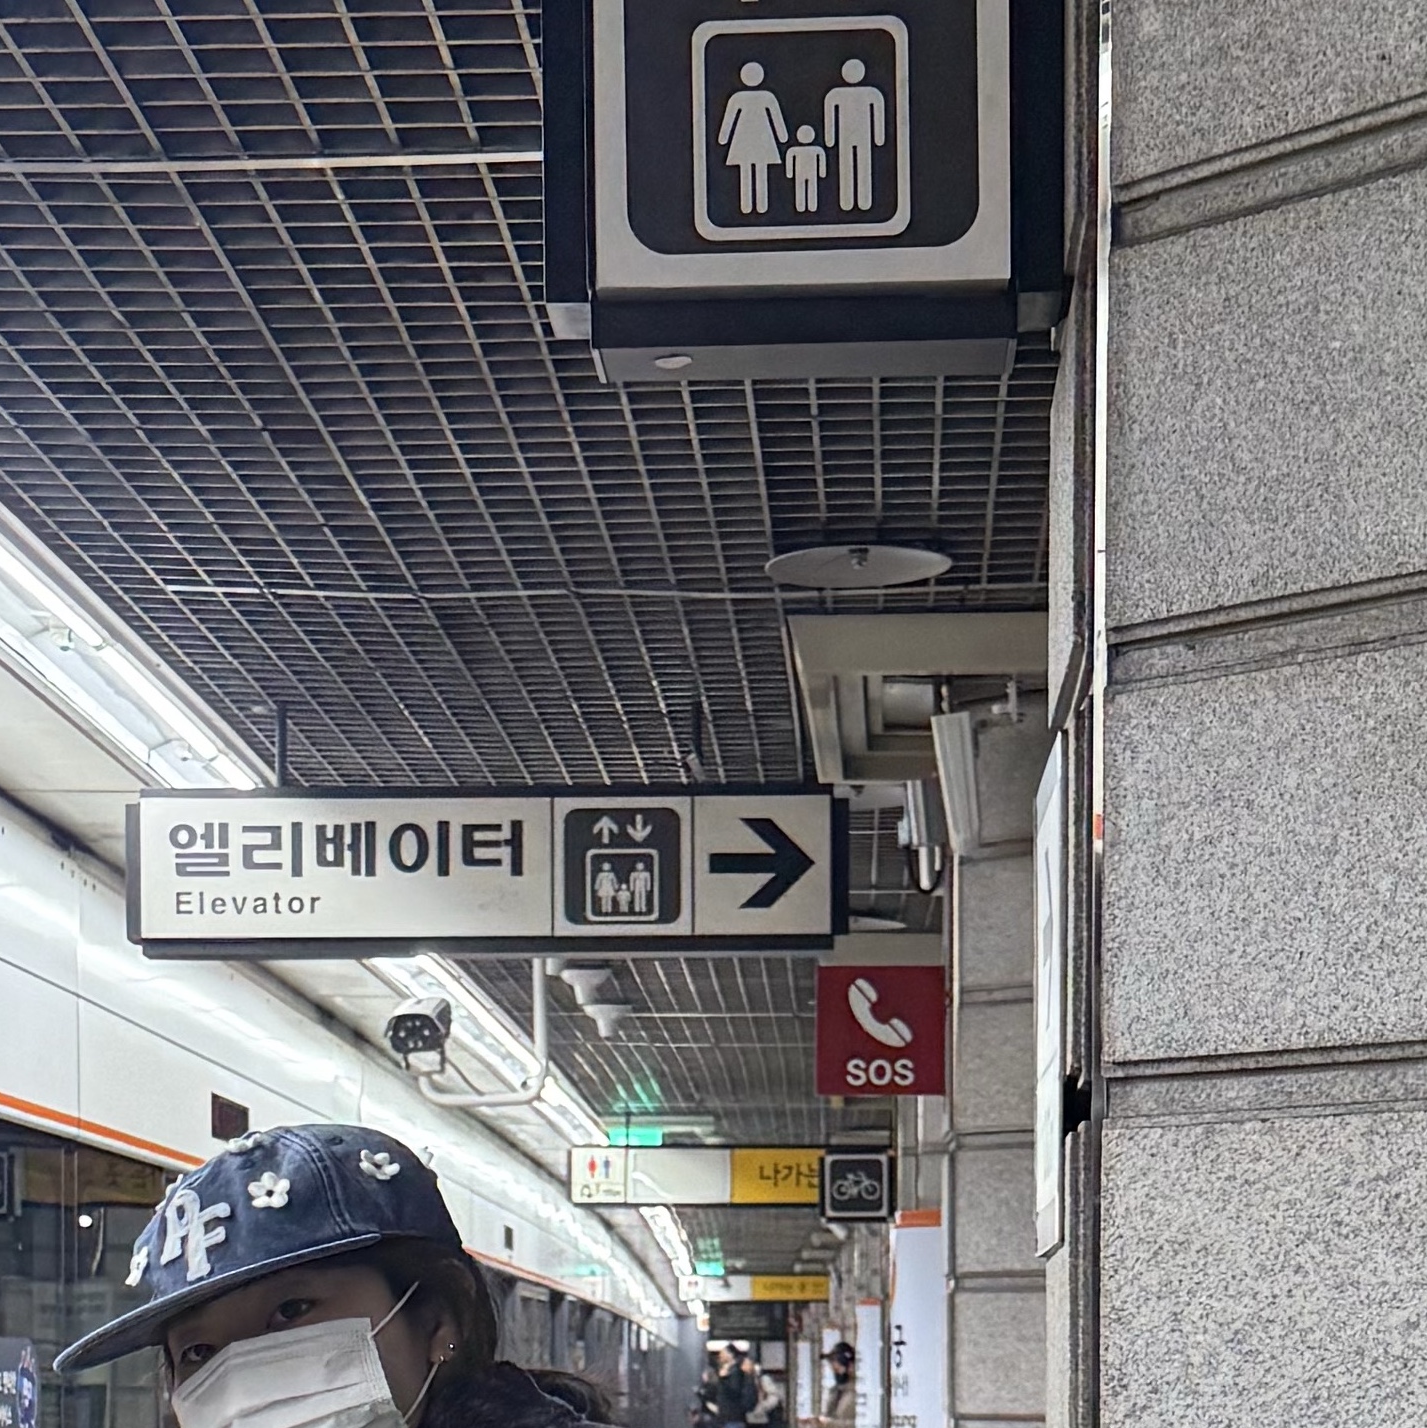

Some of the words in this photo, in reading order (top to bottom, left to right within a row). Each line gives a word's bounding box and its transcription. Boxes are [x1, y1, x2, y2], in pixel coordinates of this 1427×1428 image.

[169, 819, 524, 877] 엘리베이터
[175, 891, 321, 915] Elevator
[846, 1058, 915, 1086] SOS
